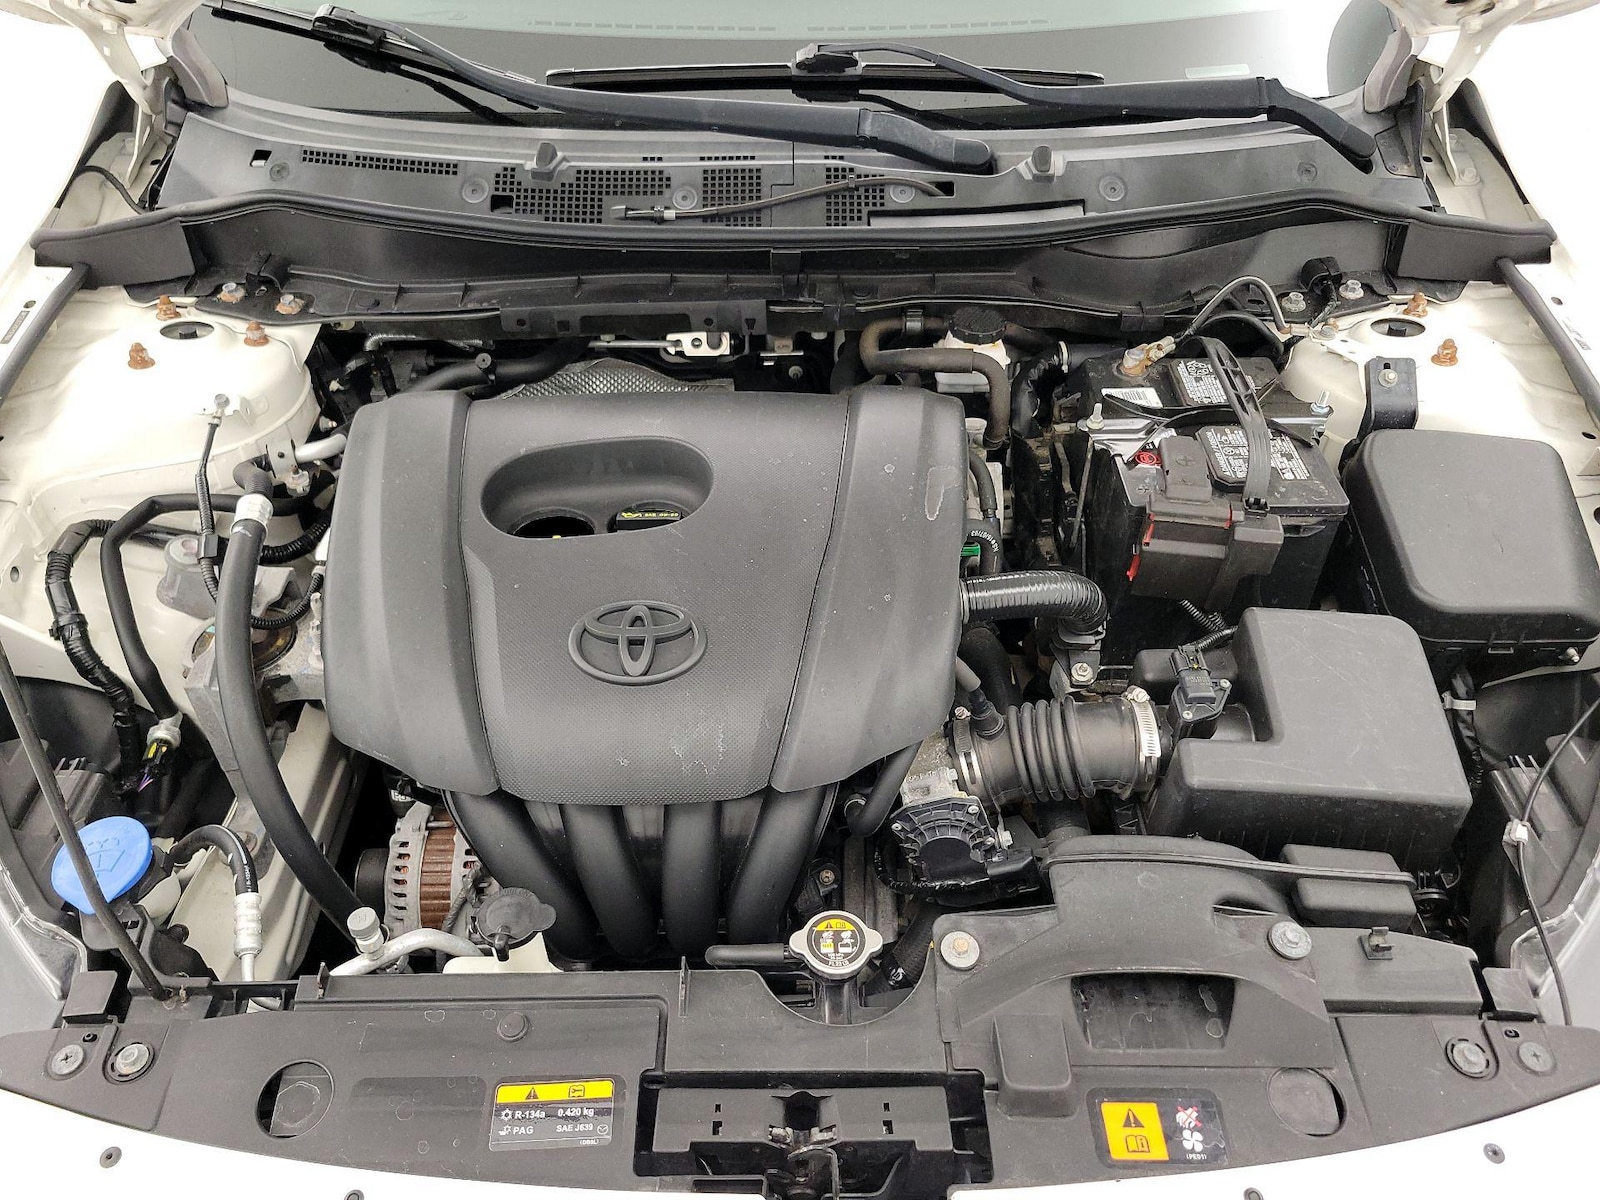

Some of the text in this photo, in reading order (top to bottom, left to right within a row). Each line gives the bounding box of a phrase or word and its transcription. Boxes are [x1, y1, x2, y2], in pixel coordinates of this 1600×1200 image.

[514, 1107, 594, 1119] R-134a 0.420 kg
[512, 1123, 594, 1135] PAG SAE J639
